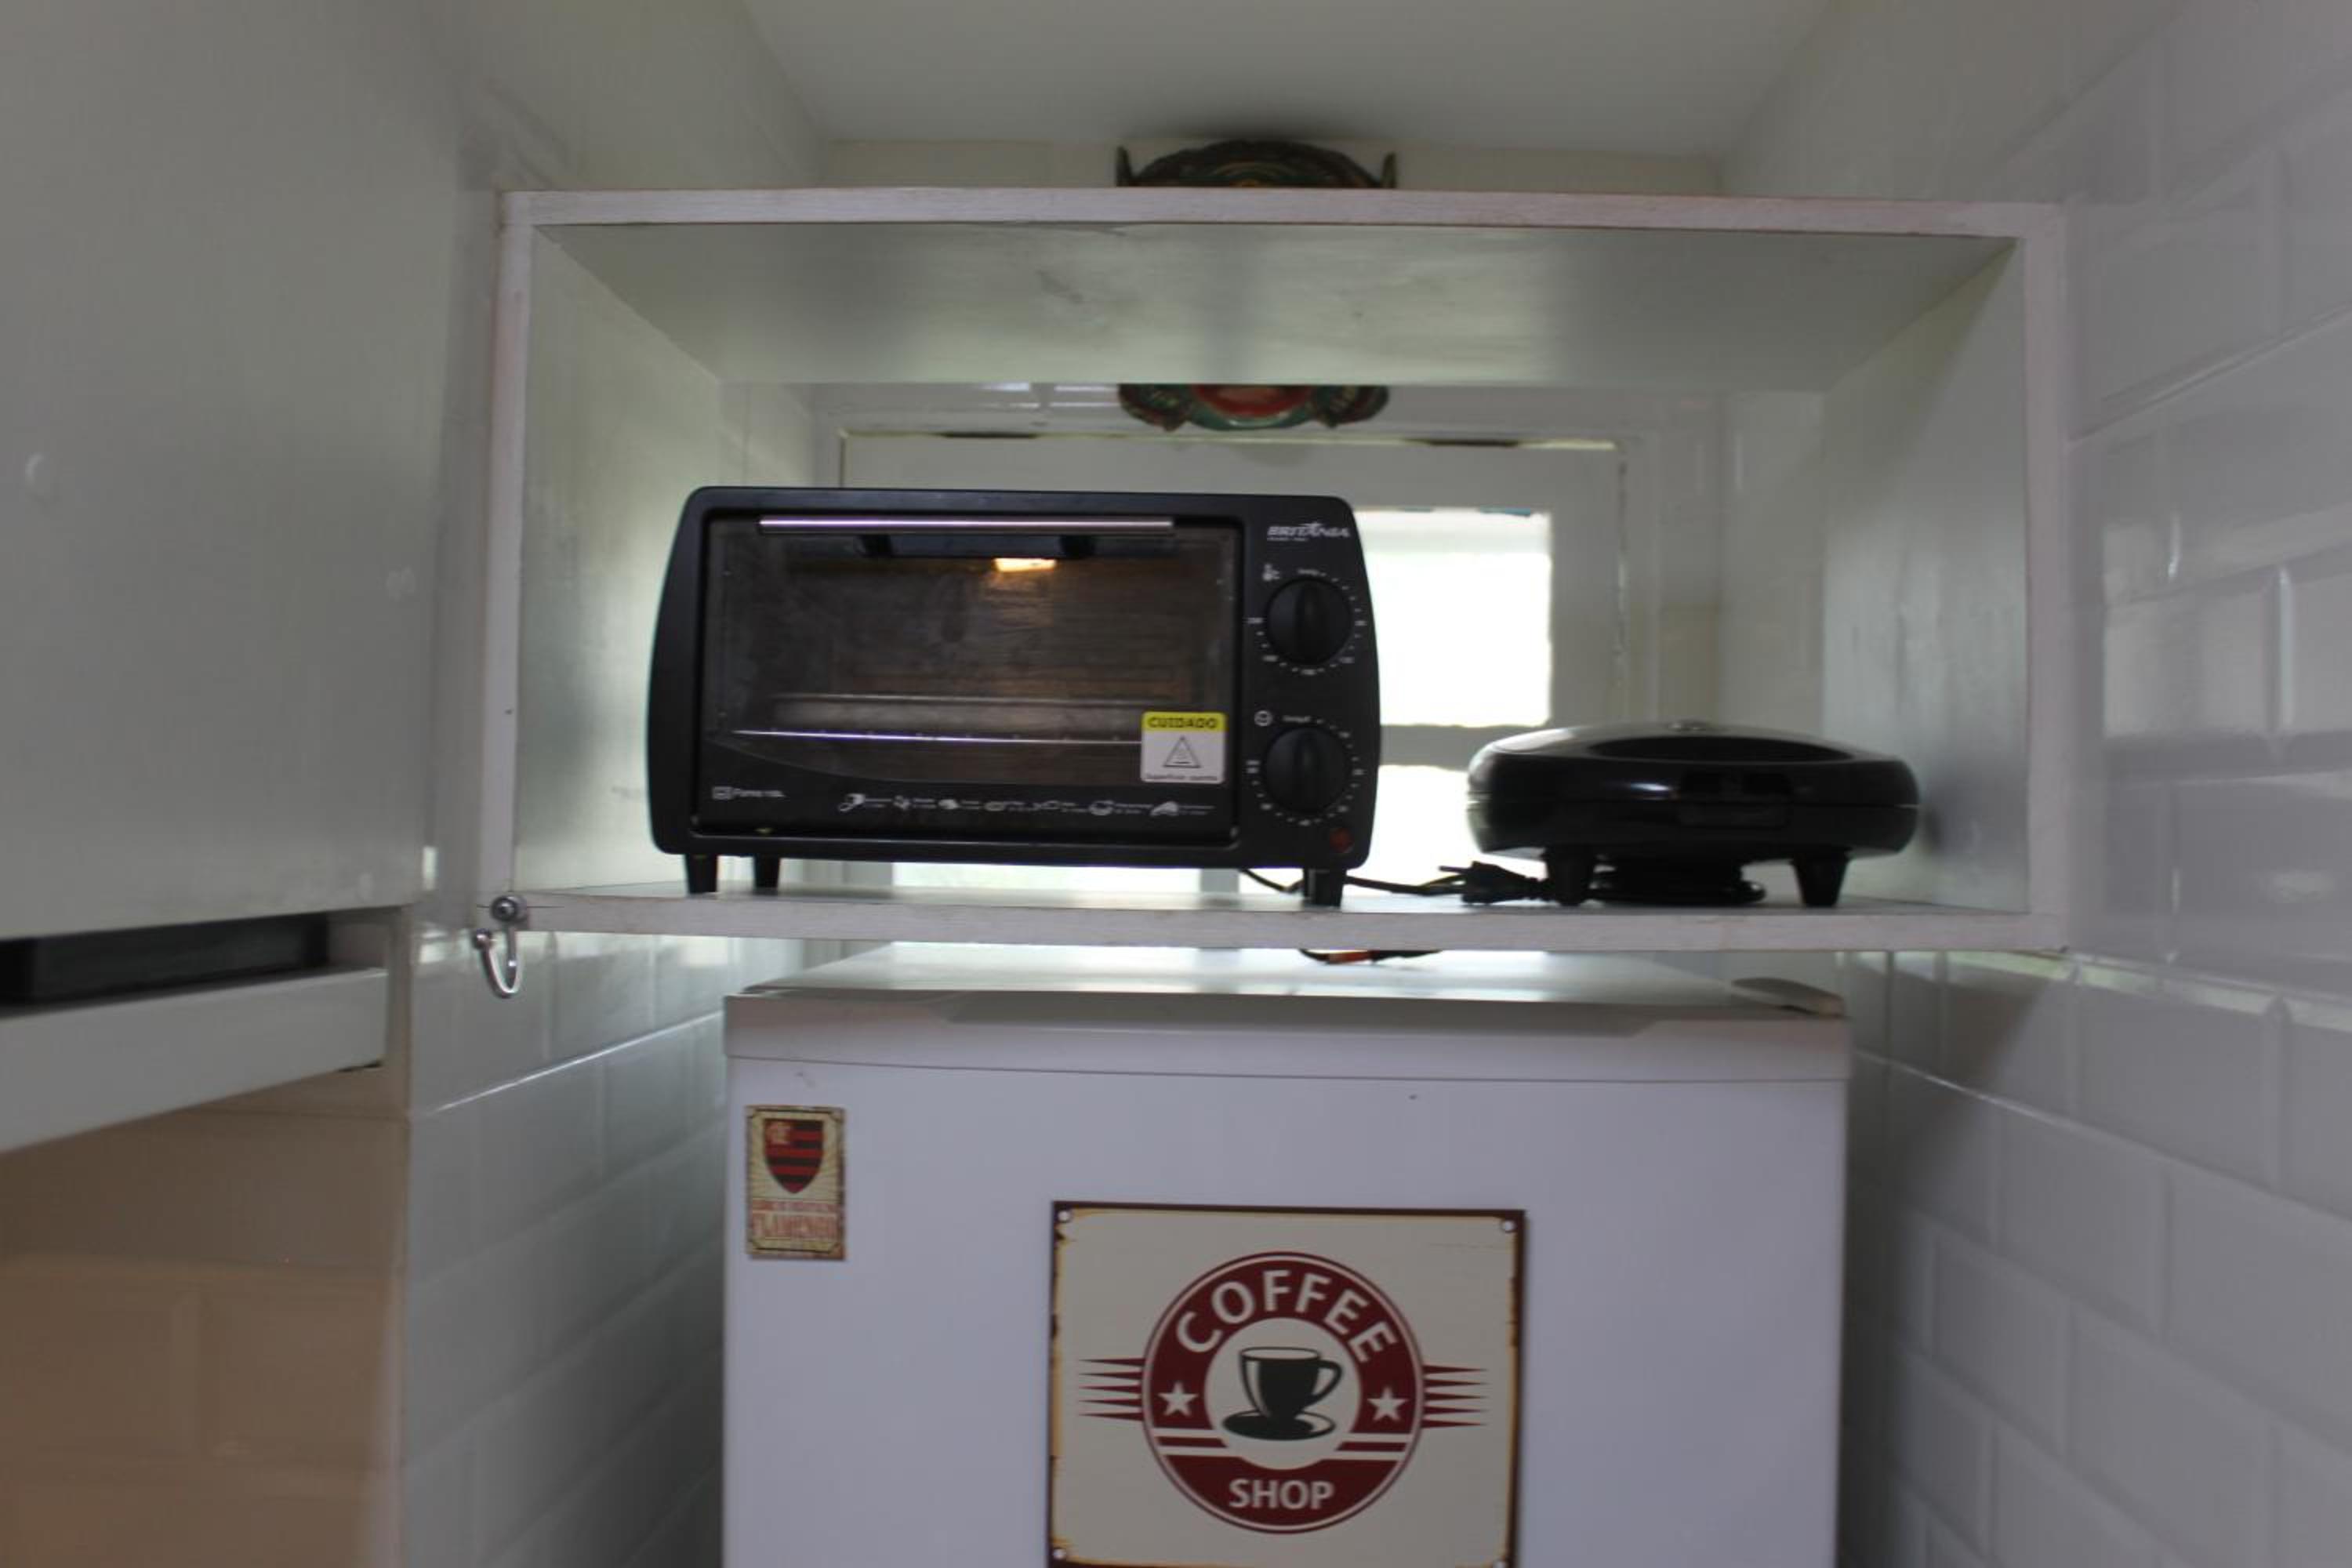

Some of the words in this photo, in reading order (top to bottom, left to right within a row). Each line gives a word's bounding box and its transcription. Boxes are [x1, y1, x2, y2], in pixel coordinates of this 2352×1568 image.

[1147, 717, 1218, 728] CUIDADO
[1176, 1269, 1396, 1363] COFFEE
[1229, 1479, 1334, 1510] SHOP
